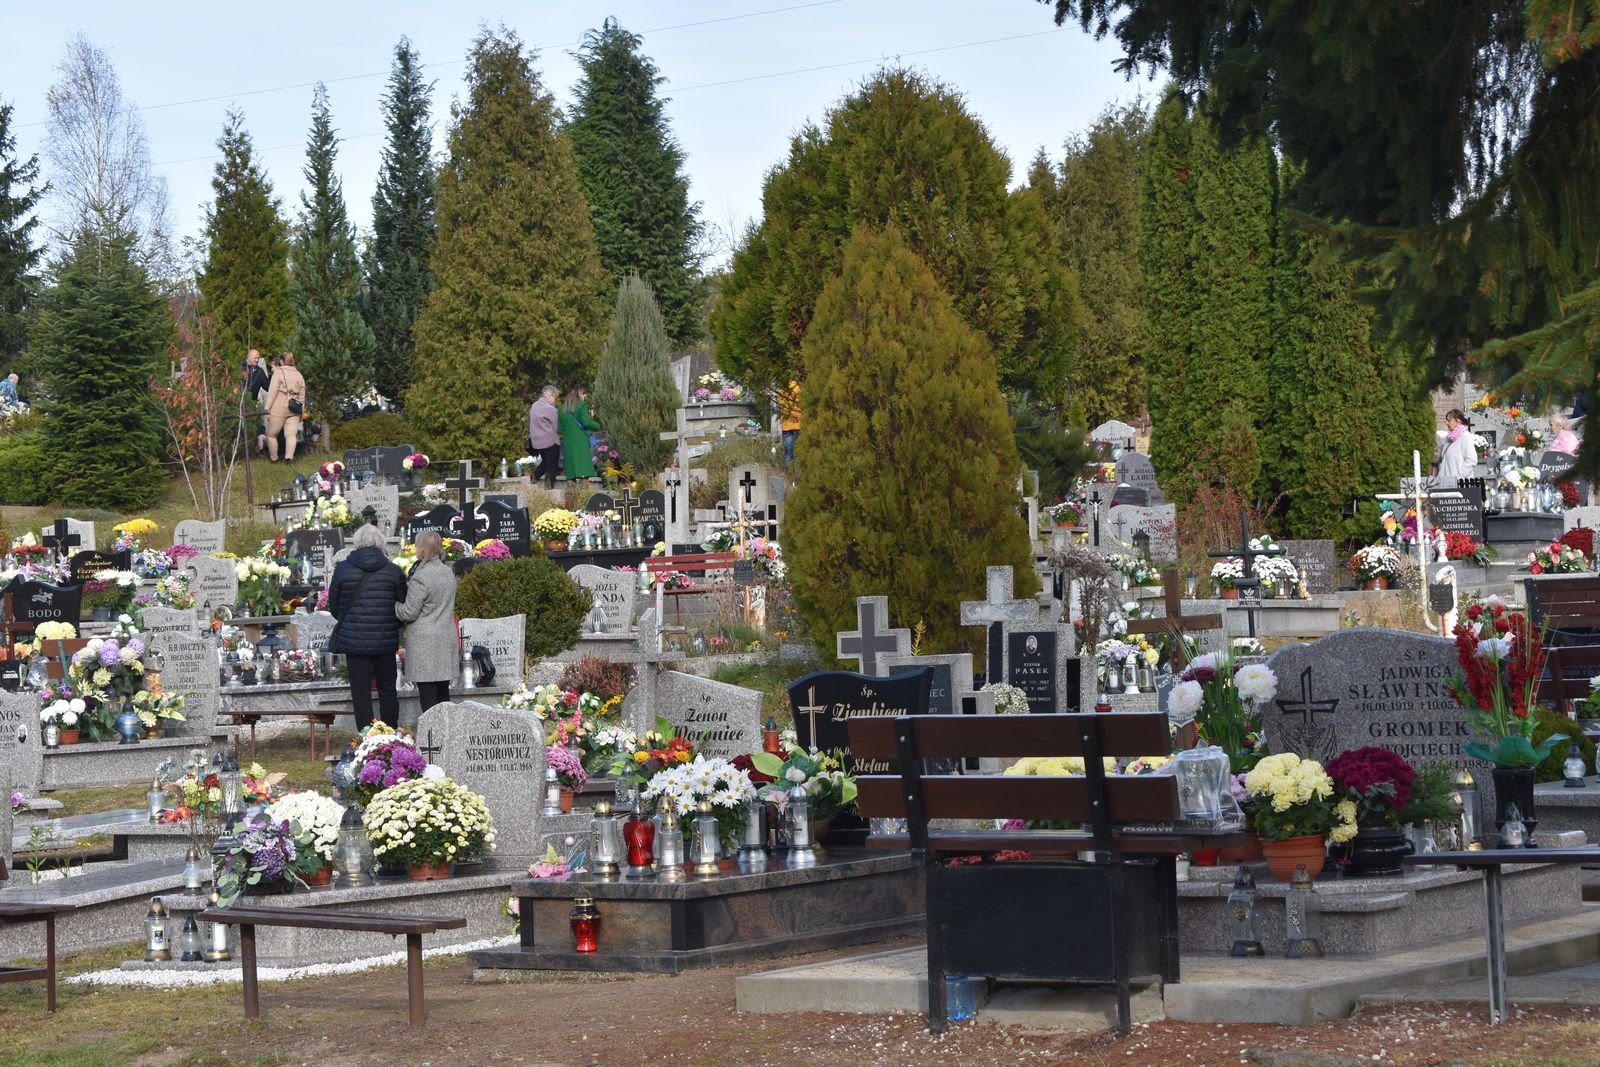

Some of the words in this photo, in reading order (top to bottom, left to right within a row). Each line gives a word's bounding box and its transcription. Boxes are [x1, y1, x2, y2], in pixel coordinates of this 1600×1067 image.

[28, 609, 62, 618] BODO
[1015, 667, 1049, 675] PASEK
[1379, 666, 1452, 682] JADWIGA
[684, 707, 728, 722] Zenon
[1369, 721, 1469, 737] GROMEK
[469, 733, 527, 746] WŁODZIMIERZ
[466, 746, 531, 761] NESTOROWICZ
[852, 758, 890, 774] Stefan
